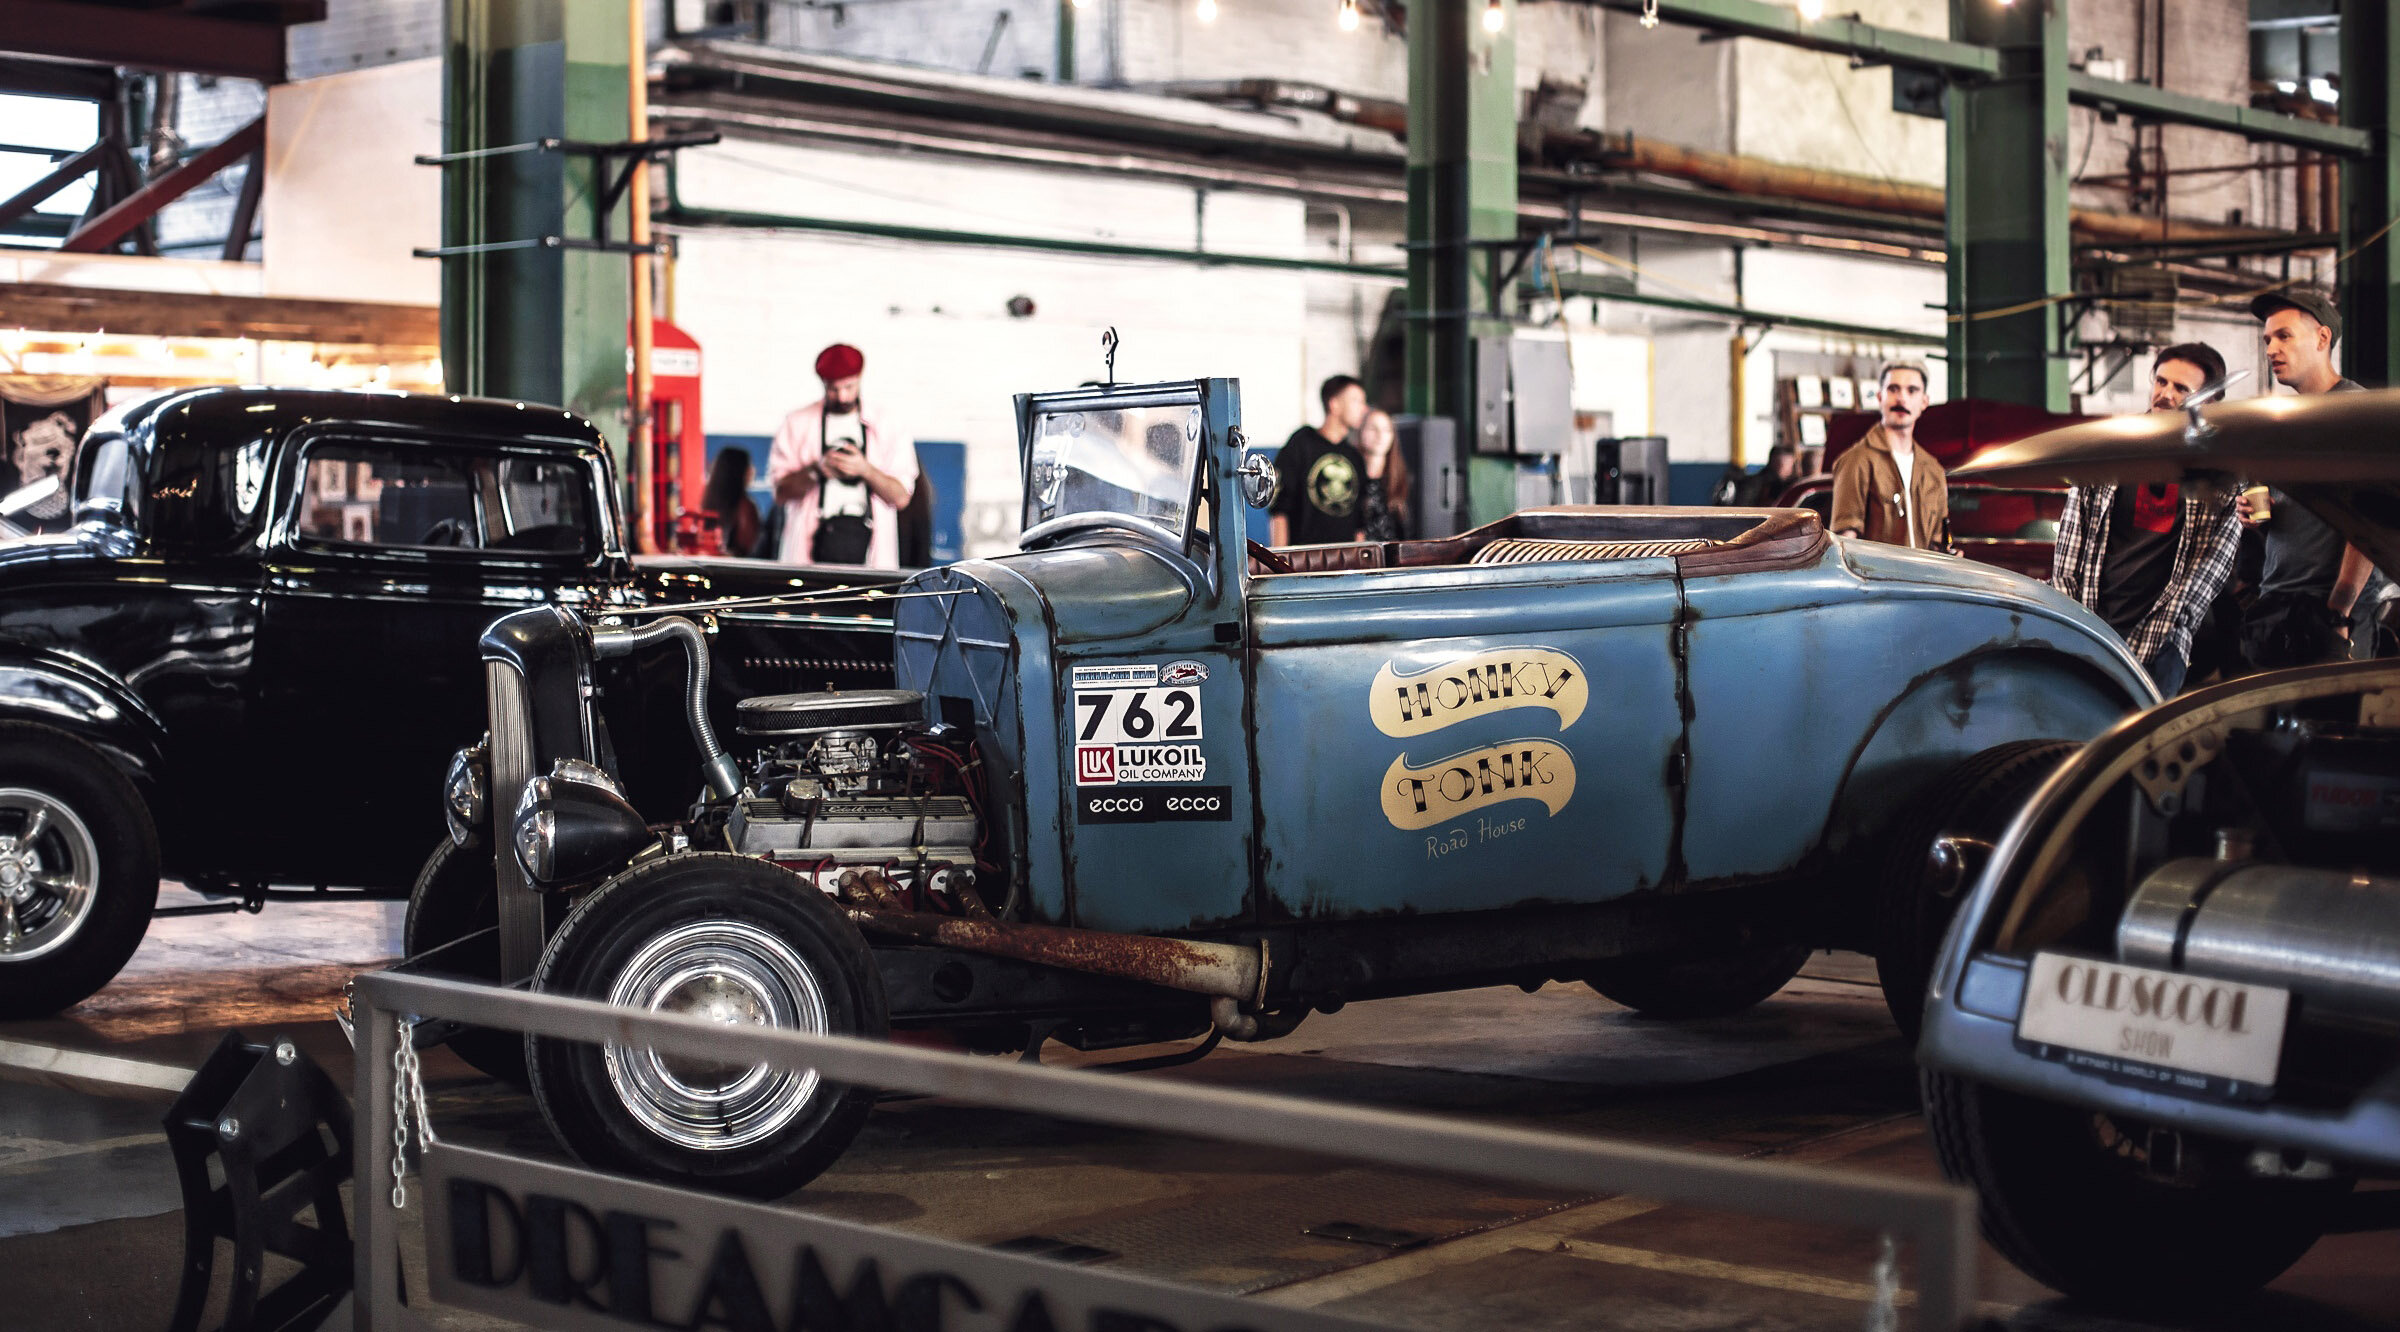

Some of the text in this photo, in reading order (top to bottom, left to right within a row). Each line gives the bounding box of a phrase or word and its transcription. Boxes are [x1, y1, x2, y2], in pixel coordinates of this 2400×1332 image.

[1394, 661, 1575, 723] HONKY
[1077, 690, 1198, 741] 762
[1118, 748, 1203, 767] LUKOIL
[1119, 768, 1204, 780] OIL COMPANY
[1089, 797, 1221, 813] ecco ecco
[1397, 750, 1555, 815] TONK
[1424, 815, 1527, 861] Road House
